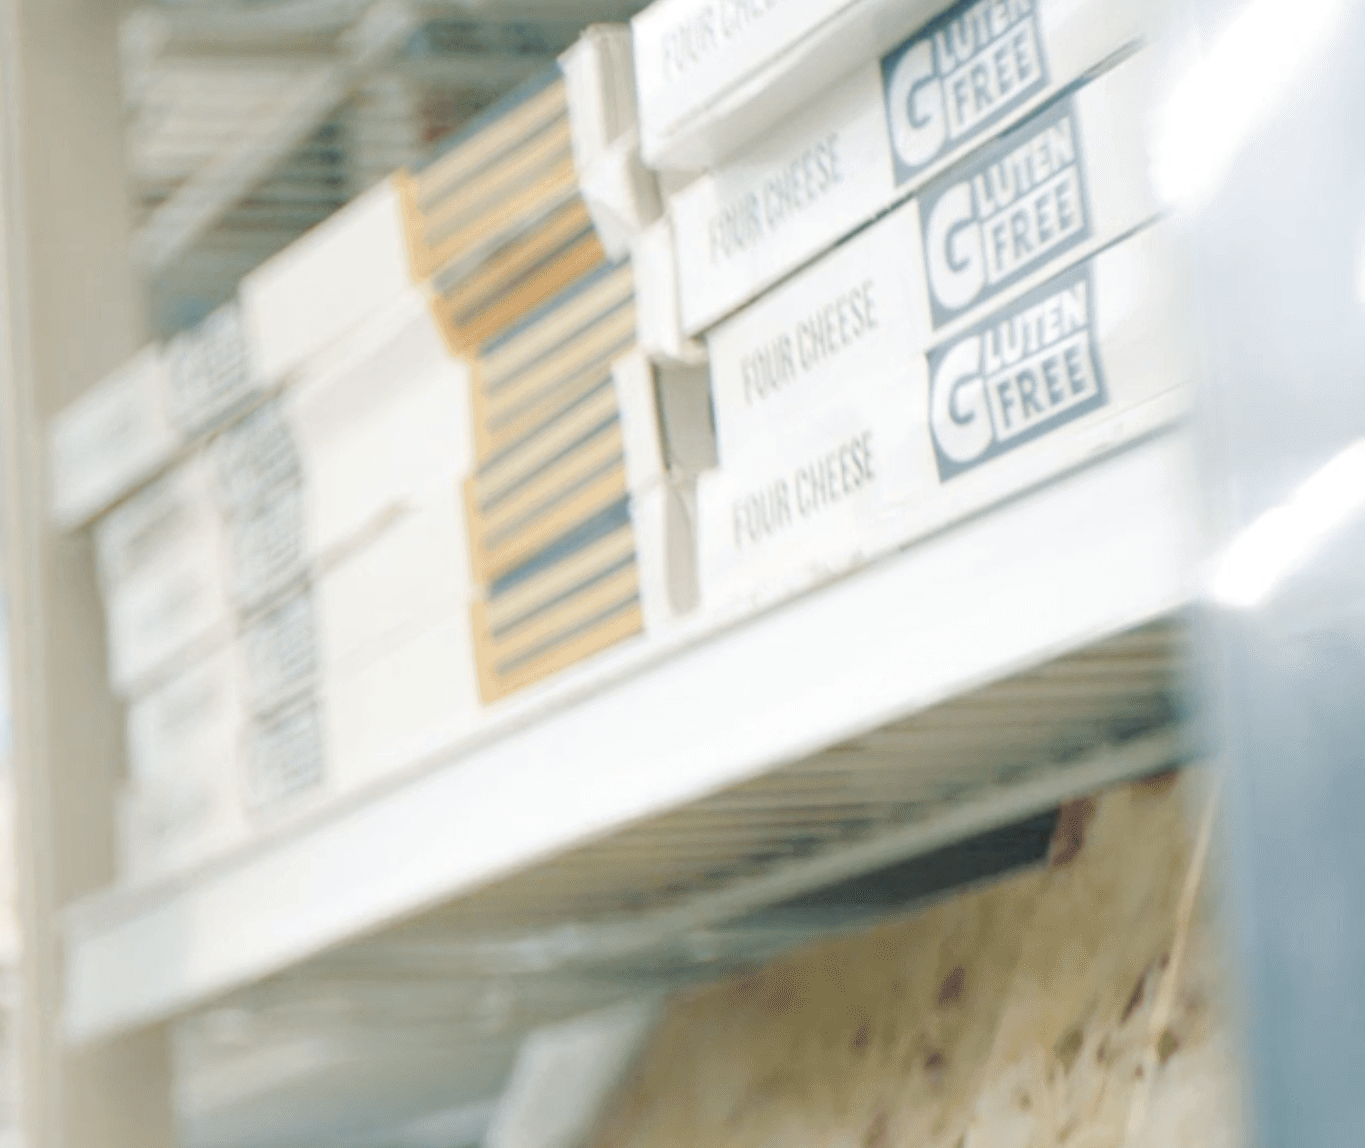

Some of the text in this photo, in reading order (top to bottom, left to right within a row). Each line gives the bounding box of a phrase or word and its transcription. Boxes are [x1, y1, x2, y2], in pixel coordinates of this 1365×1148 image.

[661, 5, 718, 82] FOUR
[953, 27, 1033, 126] FREE
[708, 131, 845, 264] FOUR CHEESE
[928, 114, 1076, 309] GLUTEN
[992, 180, 1075, 273] FREE
[741, 278, 879, 407] FOUR CHEESE
[932, 279, 1088, 463] GLUTEN
[997, 343, 1087, 430] FREE
[732, 430, 877, 551] FOUR CHEESE
